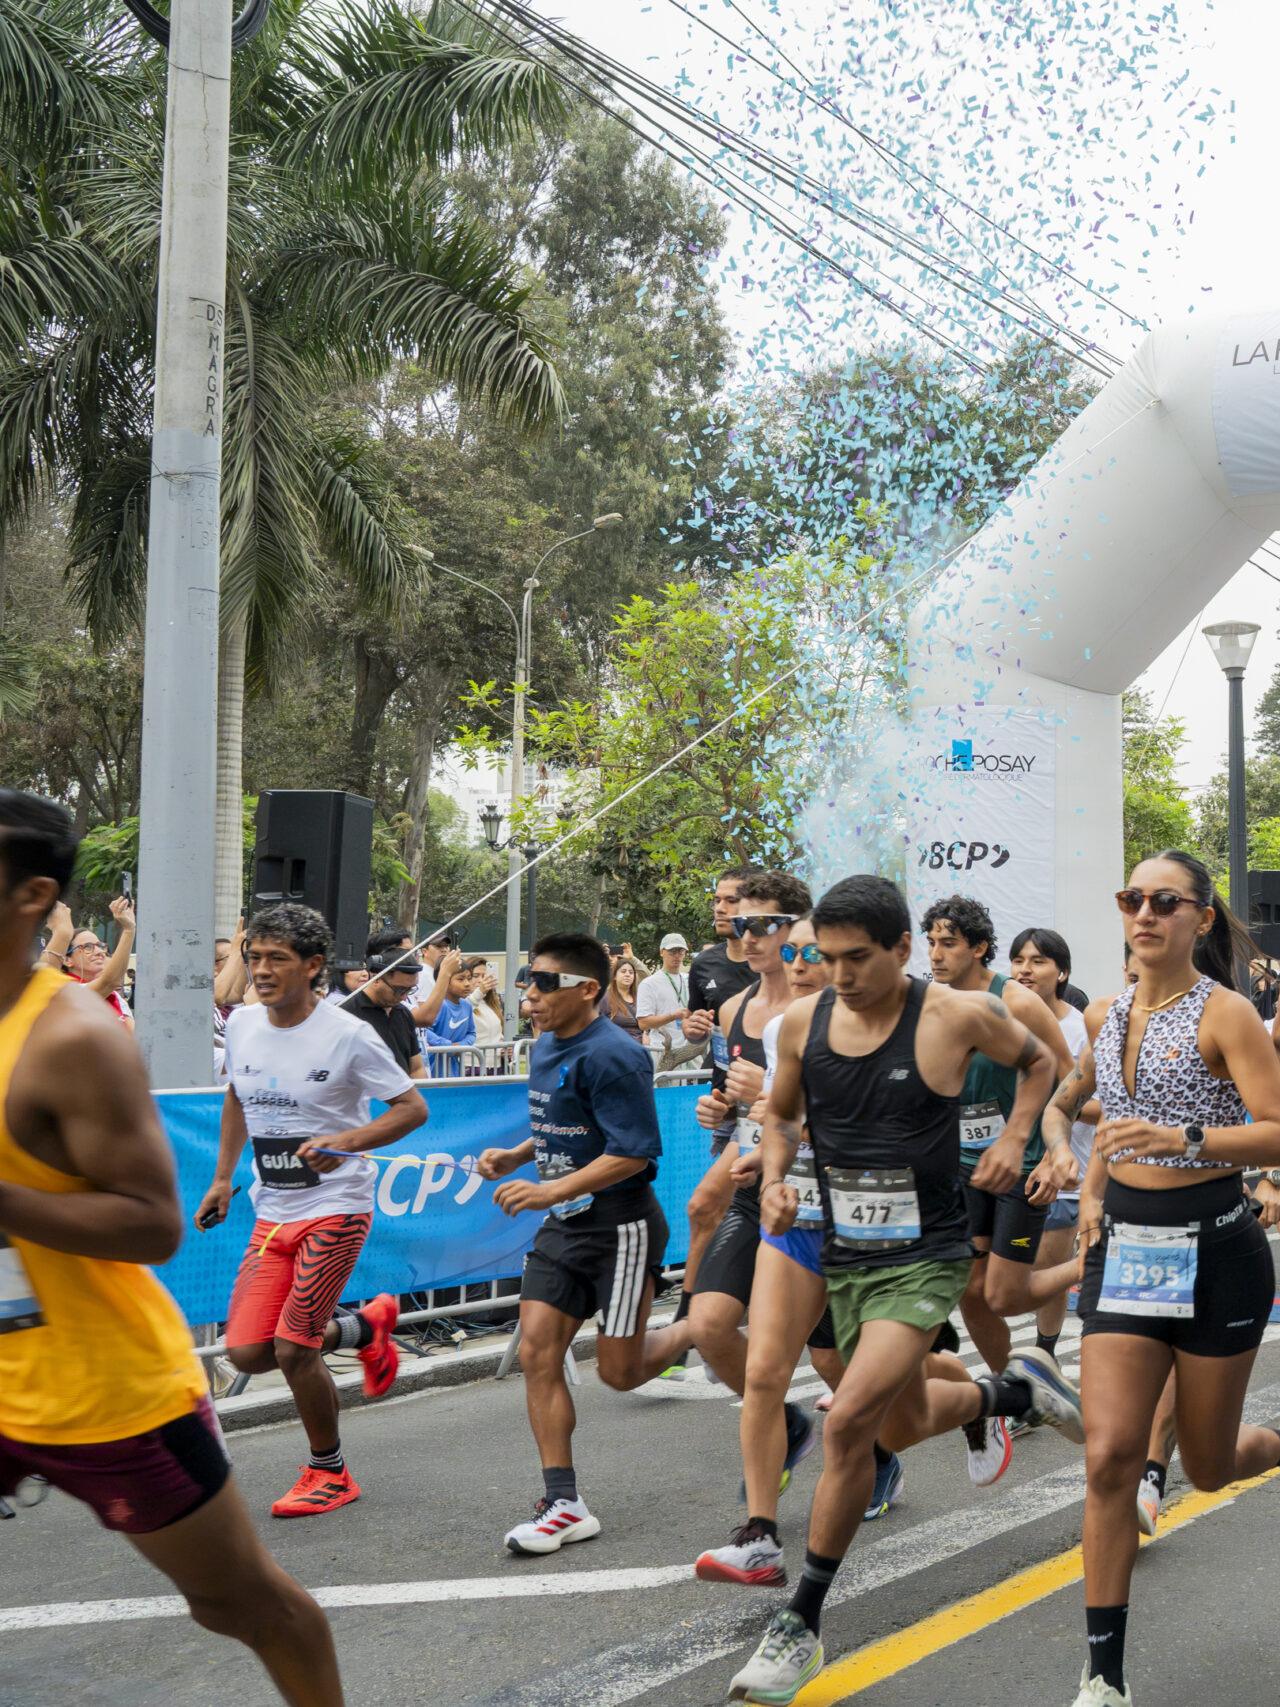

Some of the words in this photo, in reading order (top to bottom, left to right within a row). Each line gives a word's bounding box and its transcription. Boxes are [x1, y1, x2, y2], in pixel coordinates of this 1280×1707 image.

[1232, 341, 1269, 367] LA
[928, 841, 989, 871] BCP
[965, 1125, 991, 1140] 387
[261, 1151, 304, 1170] GUÍA
[368, 1152, 456, 1217] CP
[851, 1205, 892, 1224] 477
[1119, 1262, 1181, 1288] 3295
